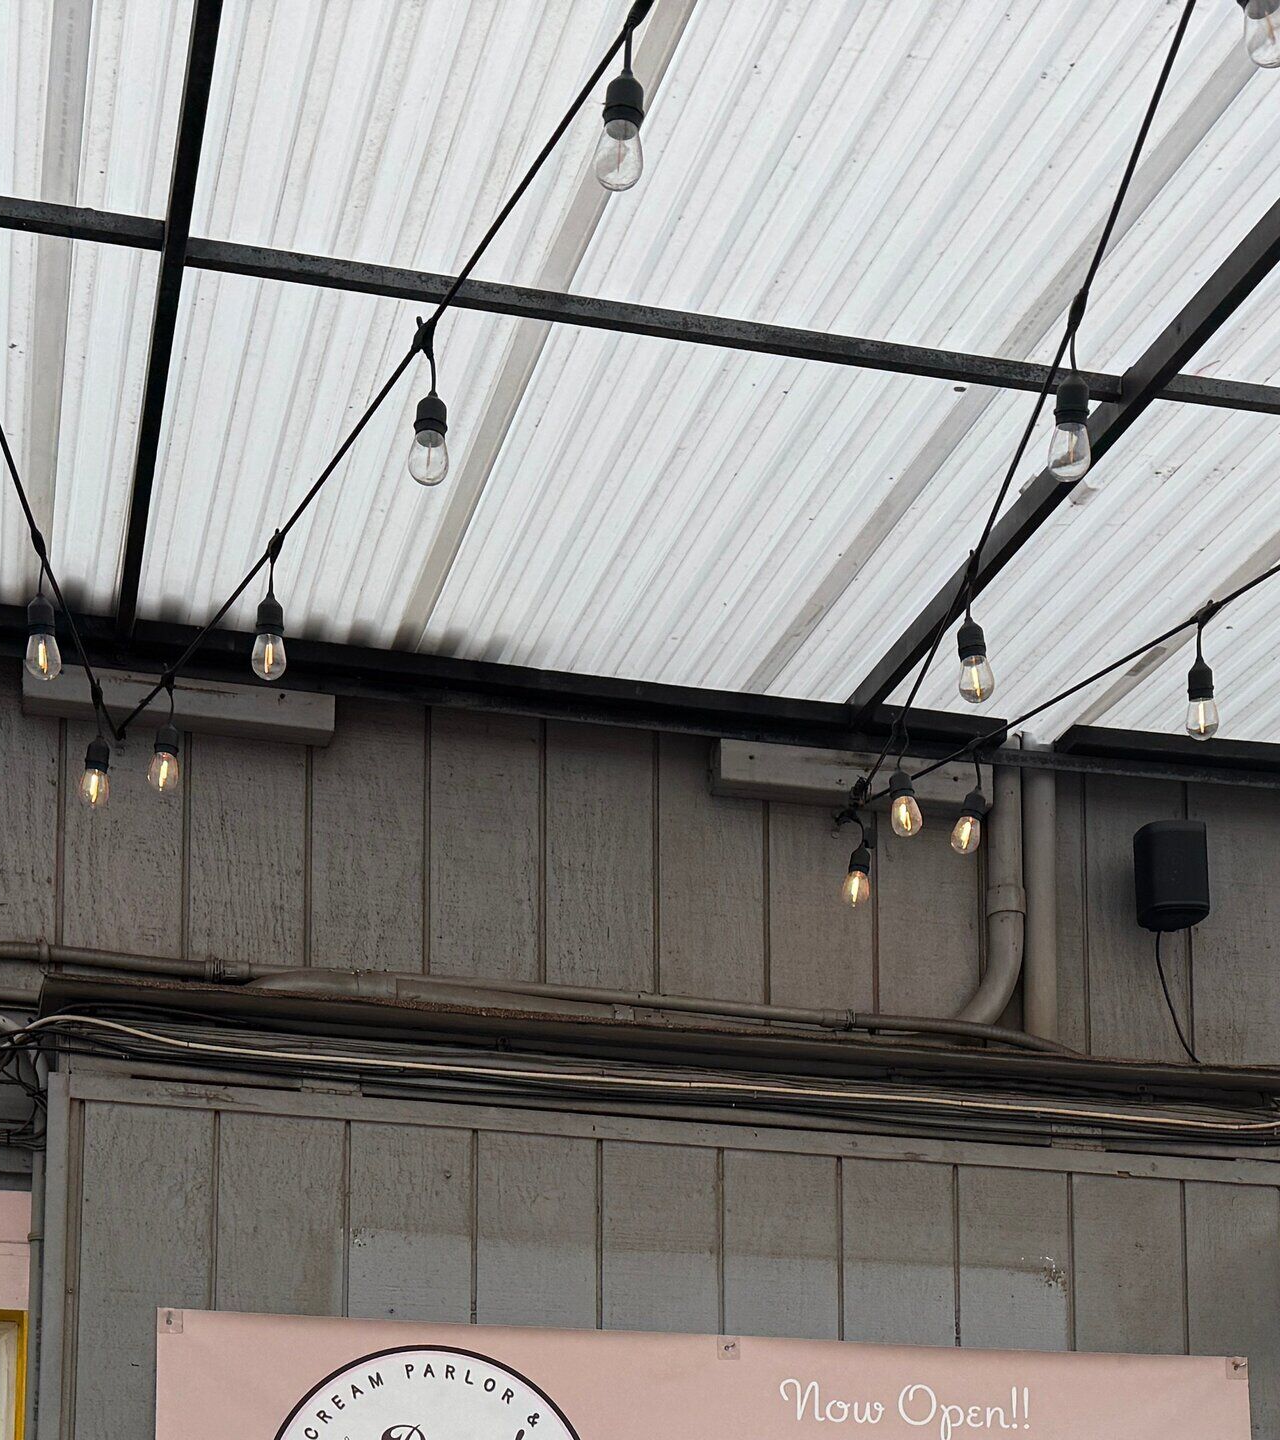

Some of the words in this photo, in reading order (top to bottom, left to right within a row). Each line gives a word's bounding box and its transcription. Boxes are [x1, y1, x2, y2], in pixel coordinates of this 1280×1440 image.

[304, 1372, 384, 1440] CREAM
[405, 1363, 514, 1404] PARLOR
[527, 1412, 540, 1427] &
[779, 1378, 885, 1425] Now
